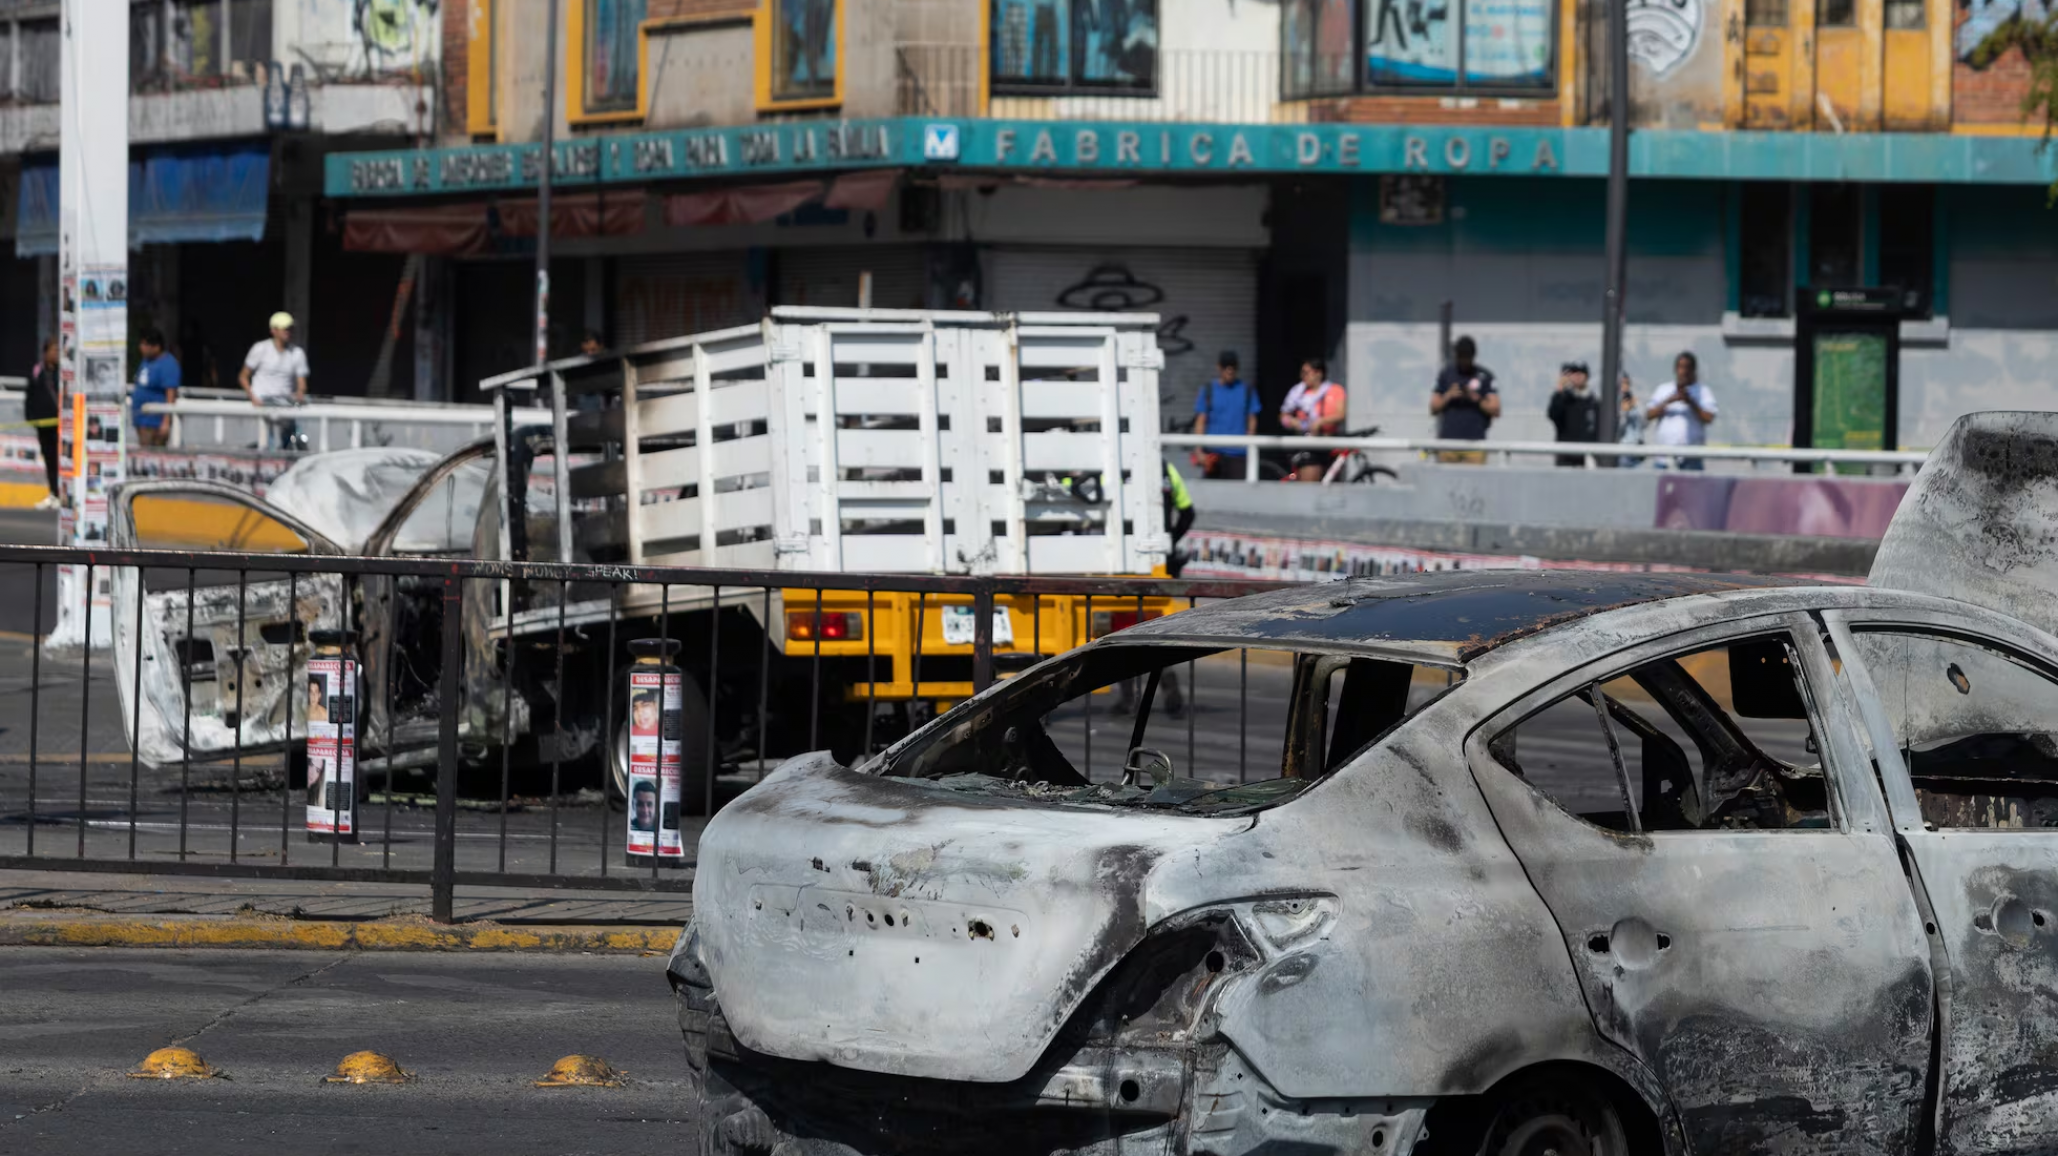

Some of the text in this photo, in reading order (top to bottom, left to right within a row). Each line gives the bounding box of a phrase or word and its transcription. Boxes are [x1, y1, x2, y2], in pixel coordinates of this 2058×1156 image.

[996, 129, 1558, 170] FABRICA DE ROPA
